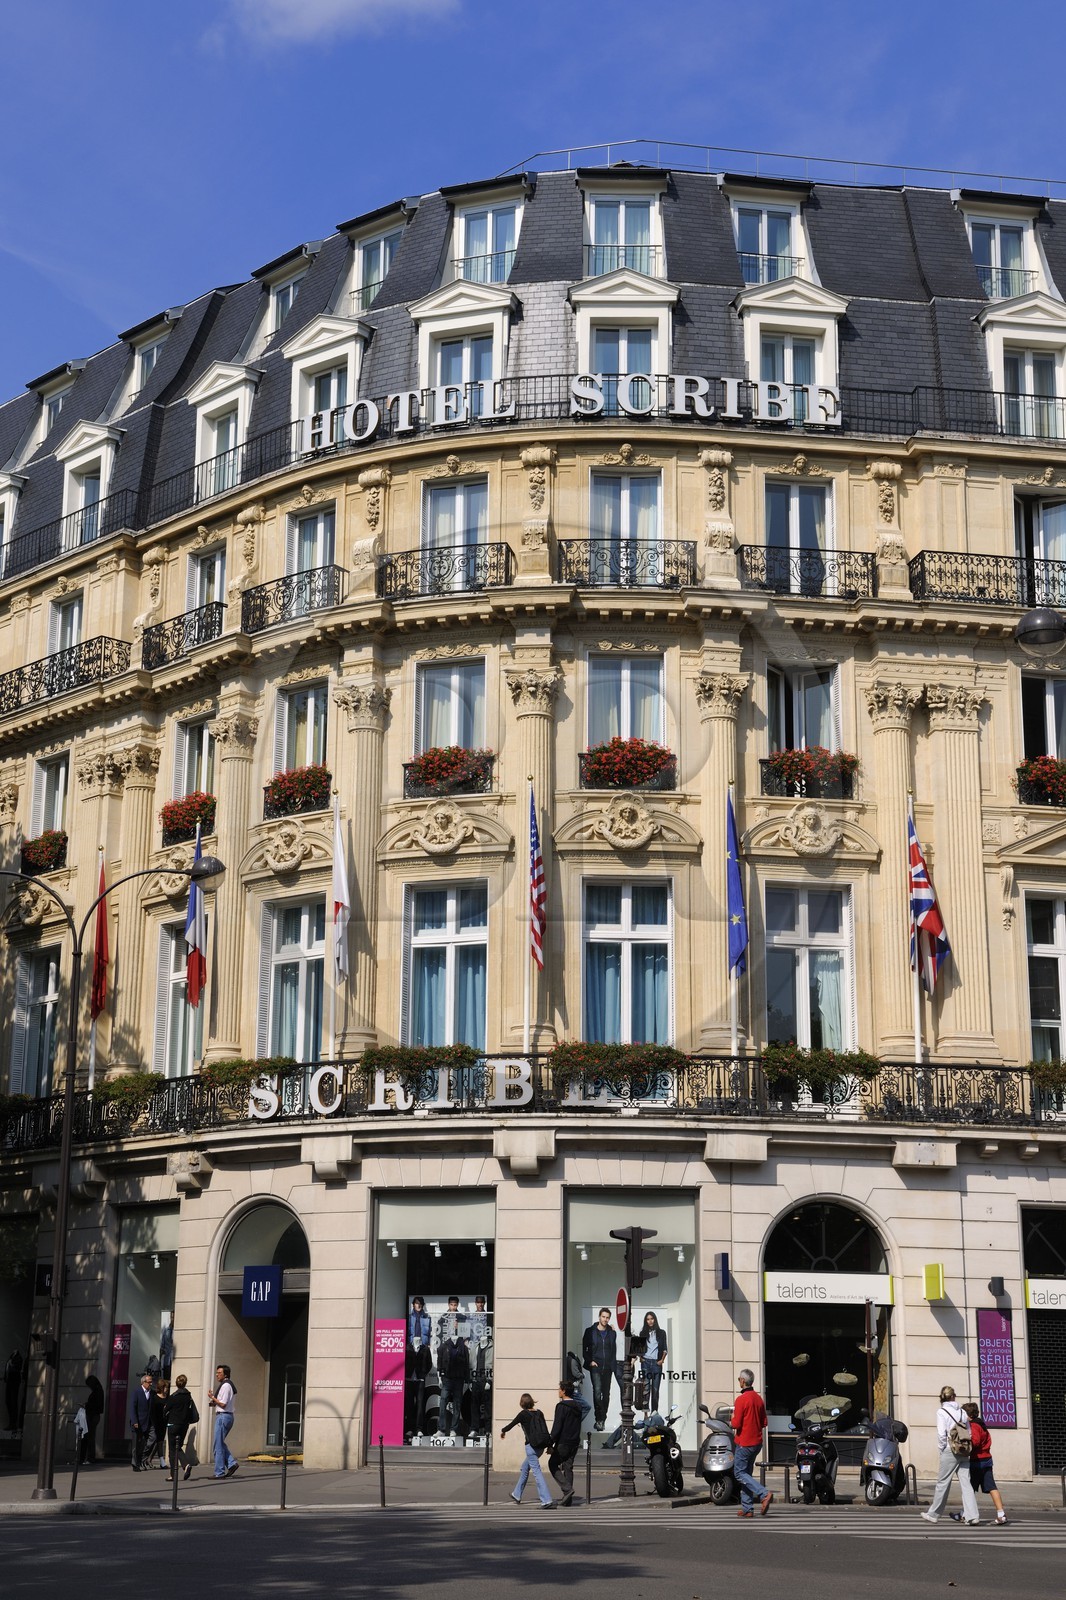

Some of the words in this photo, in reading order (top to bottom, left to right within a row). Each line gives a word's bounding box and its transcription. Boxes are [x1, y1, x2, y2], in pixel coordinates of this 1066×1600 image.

[300, 379, 516, 454] HOTEL
[570, 372, 843, 426] SCRIBE
[250, 1281, 271, 1301] GAP
[777, 1283, 827, 1299] talents
[114, 1340, 129, 1350] -50%
[376, 1337, 404, 1348] -50%
[979, 1338, 1012, 1348] OBJETS
[979, 1353, 1013, 1365] SÉRIE
[666, 1370, 680, 1380] To
[682, 1370, 697, 1380] Fit
[980, 1365, 1013, 1374] LIMITÉE
[981, 1379, 1014, 1388] SAVOIR
[981, 1389, 1014, 1400] FAIRE
[982, 1402, 1015, 1413] INNO
[982, 1413, 1016, 1423] VATION
